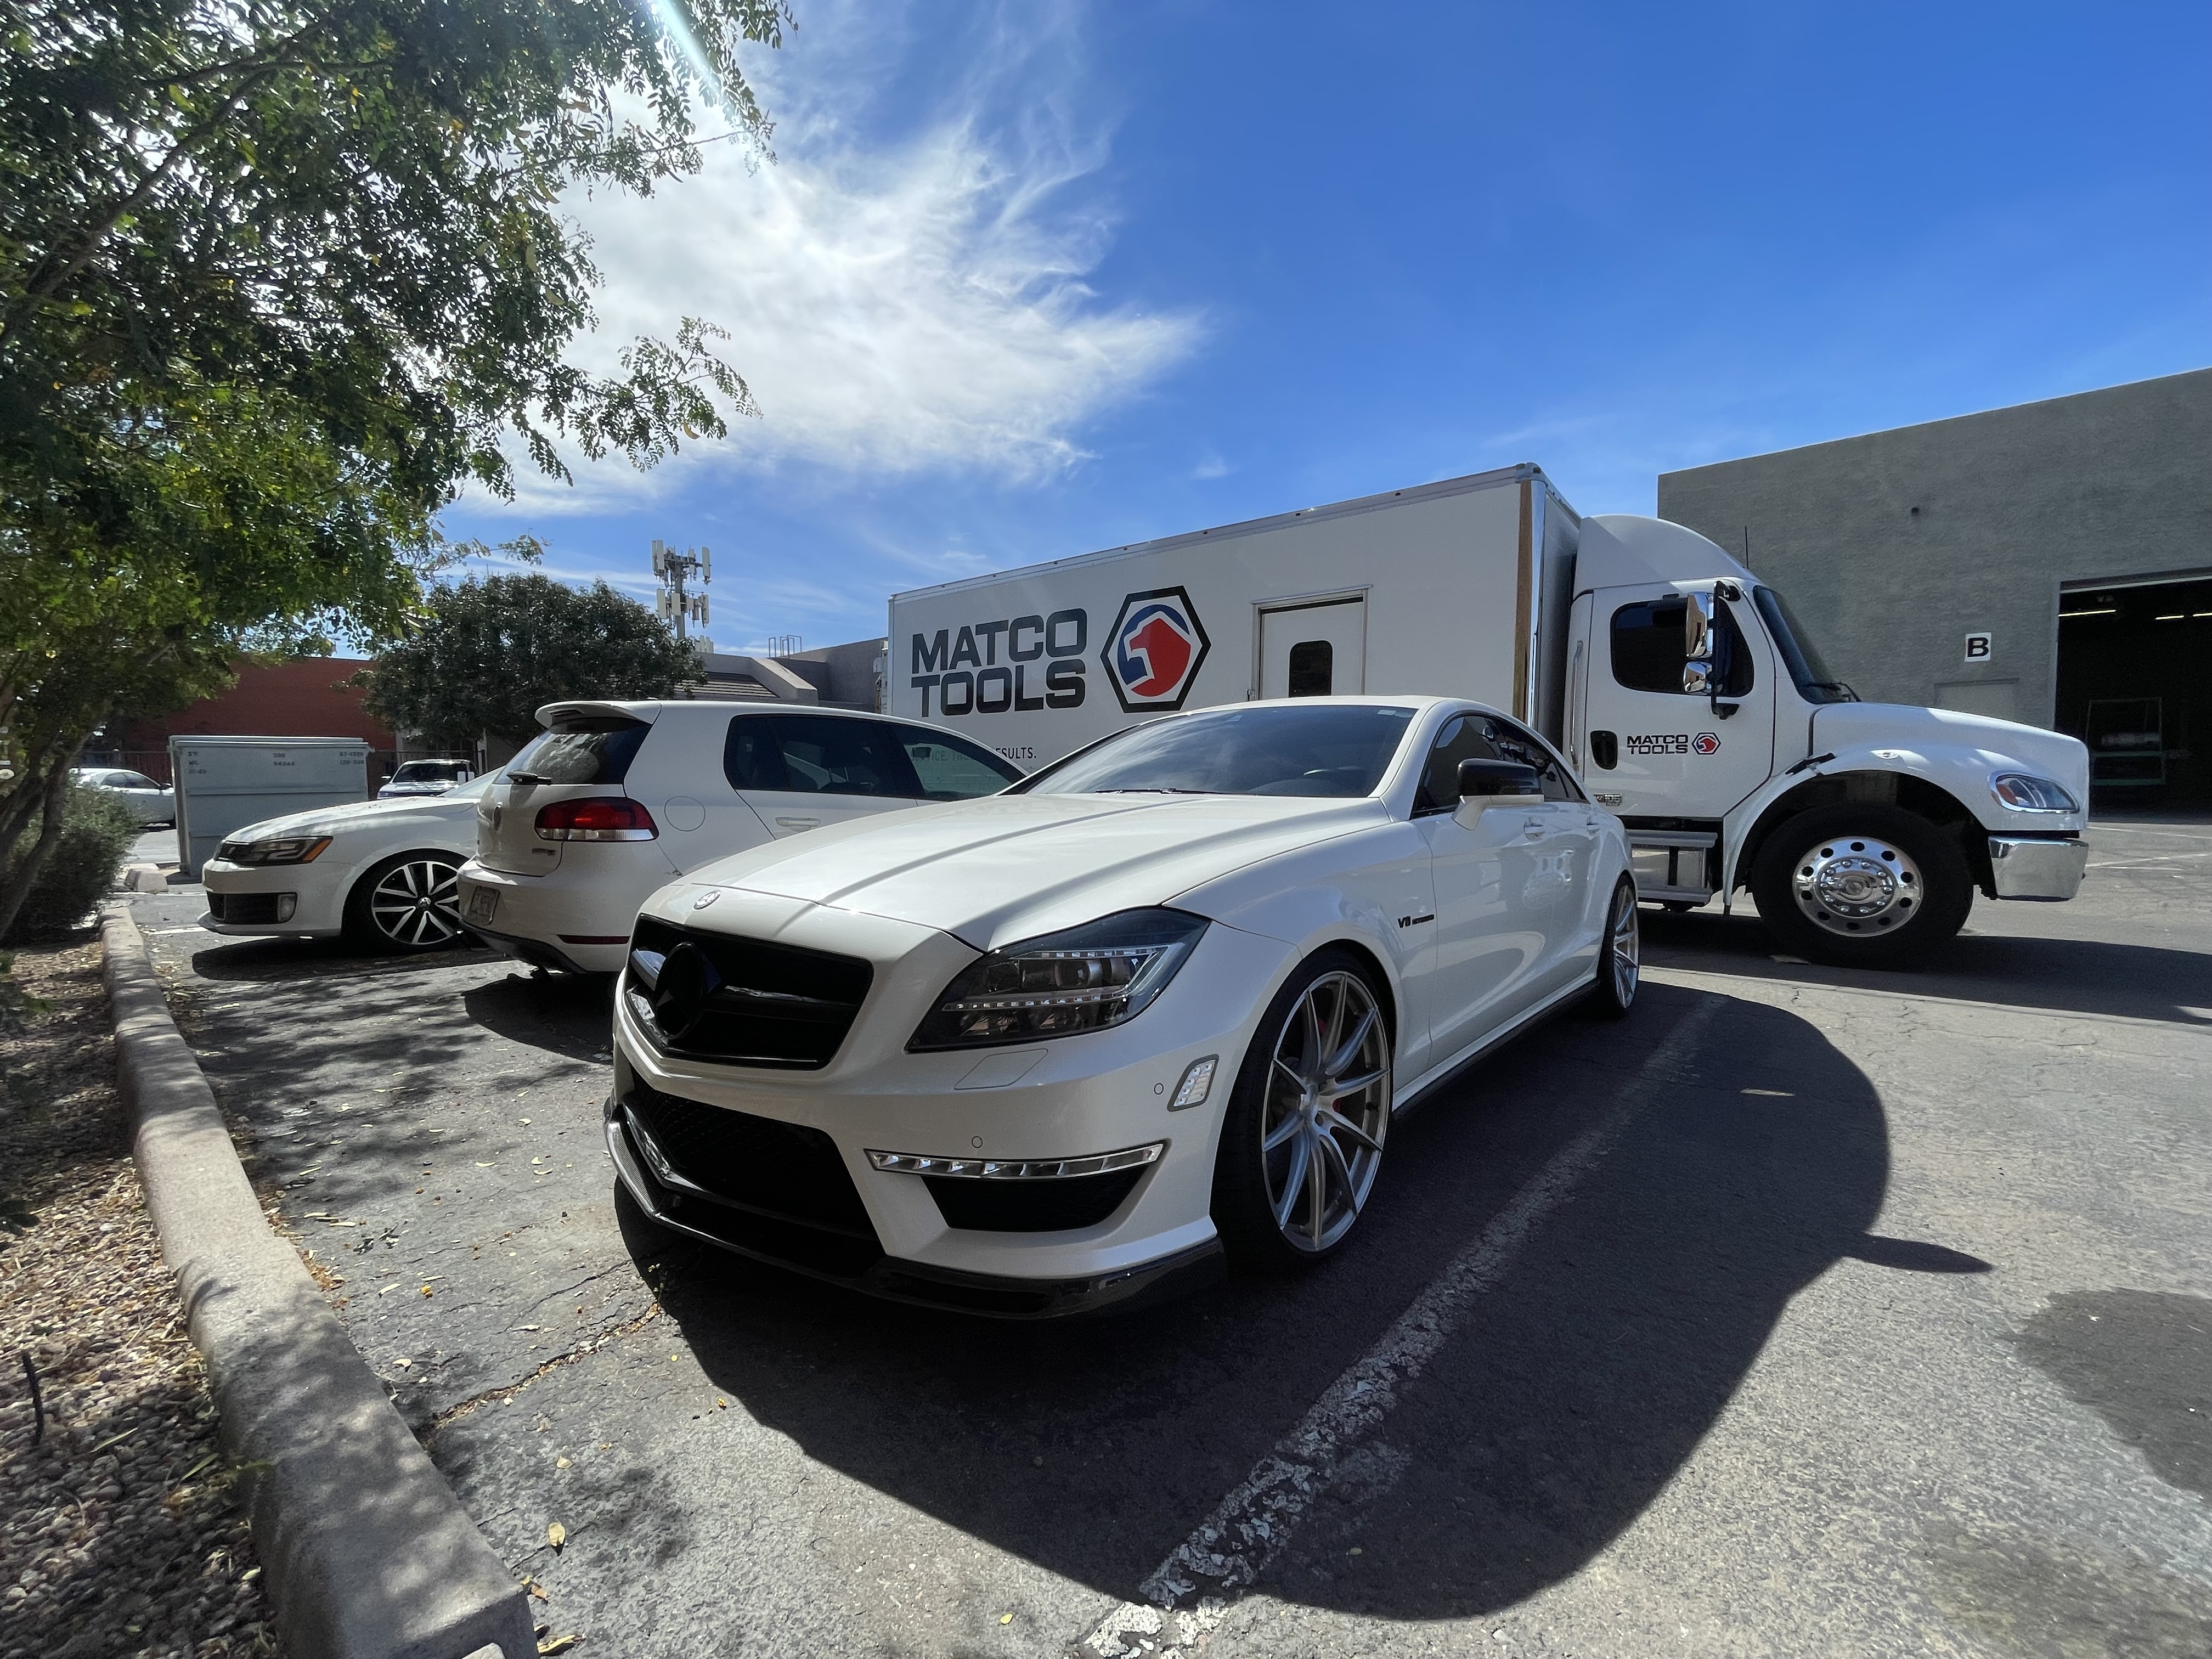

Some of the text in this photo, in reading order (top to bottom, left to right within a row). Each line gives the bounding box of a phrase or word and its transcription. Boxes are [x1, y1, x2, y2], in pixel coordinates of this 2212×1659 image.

[911, 608, 1087, 674] MATCO
[1967, 637, 1989, 658] B
[911, 658, 1087, 718] TOOLS
[1627, 734, 1689, 744] MATCO
[1627, 744, 1689, 755] TOOLS
